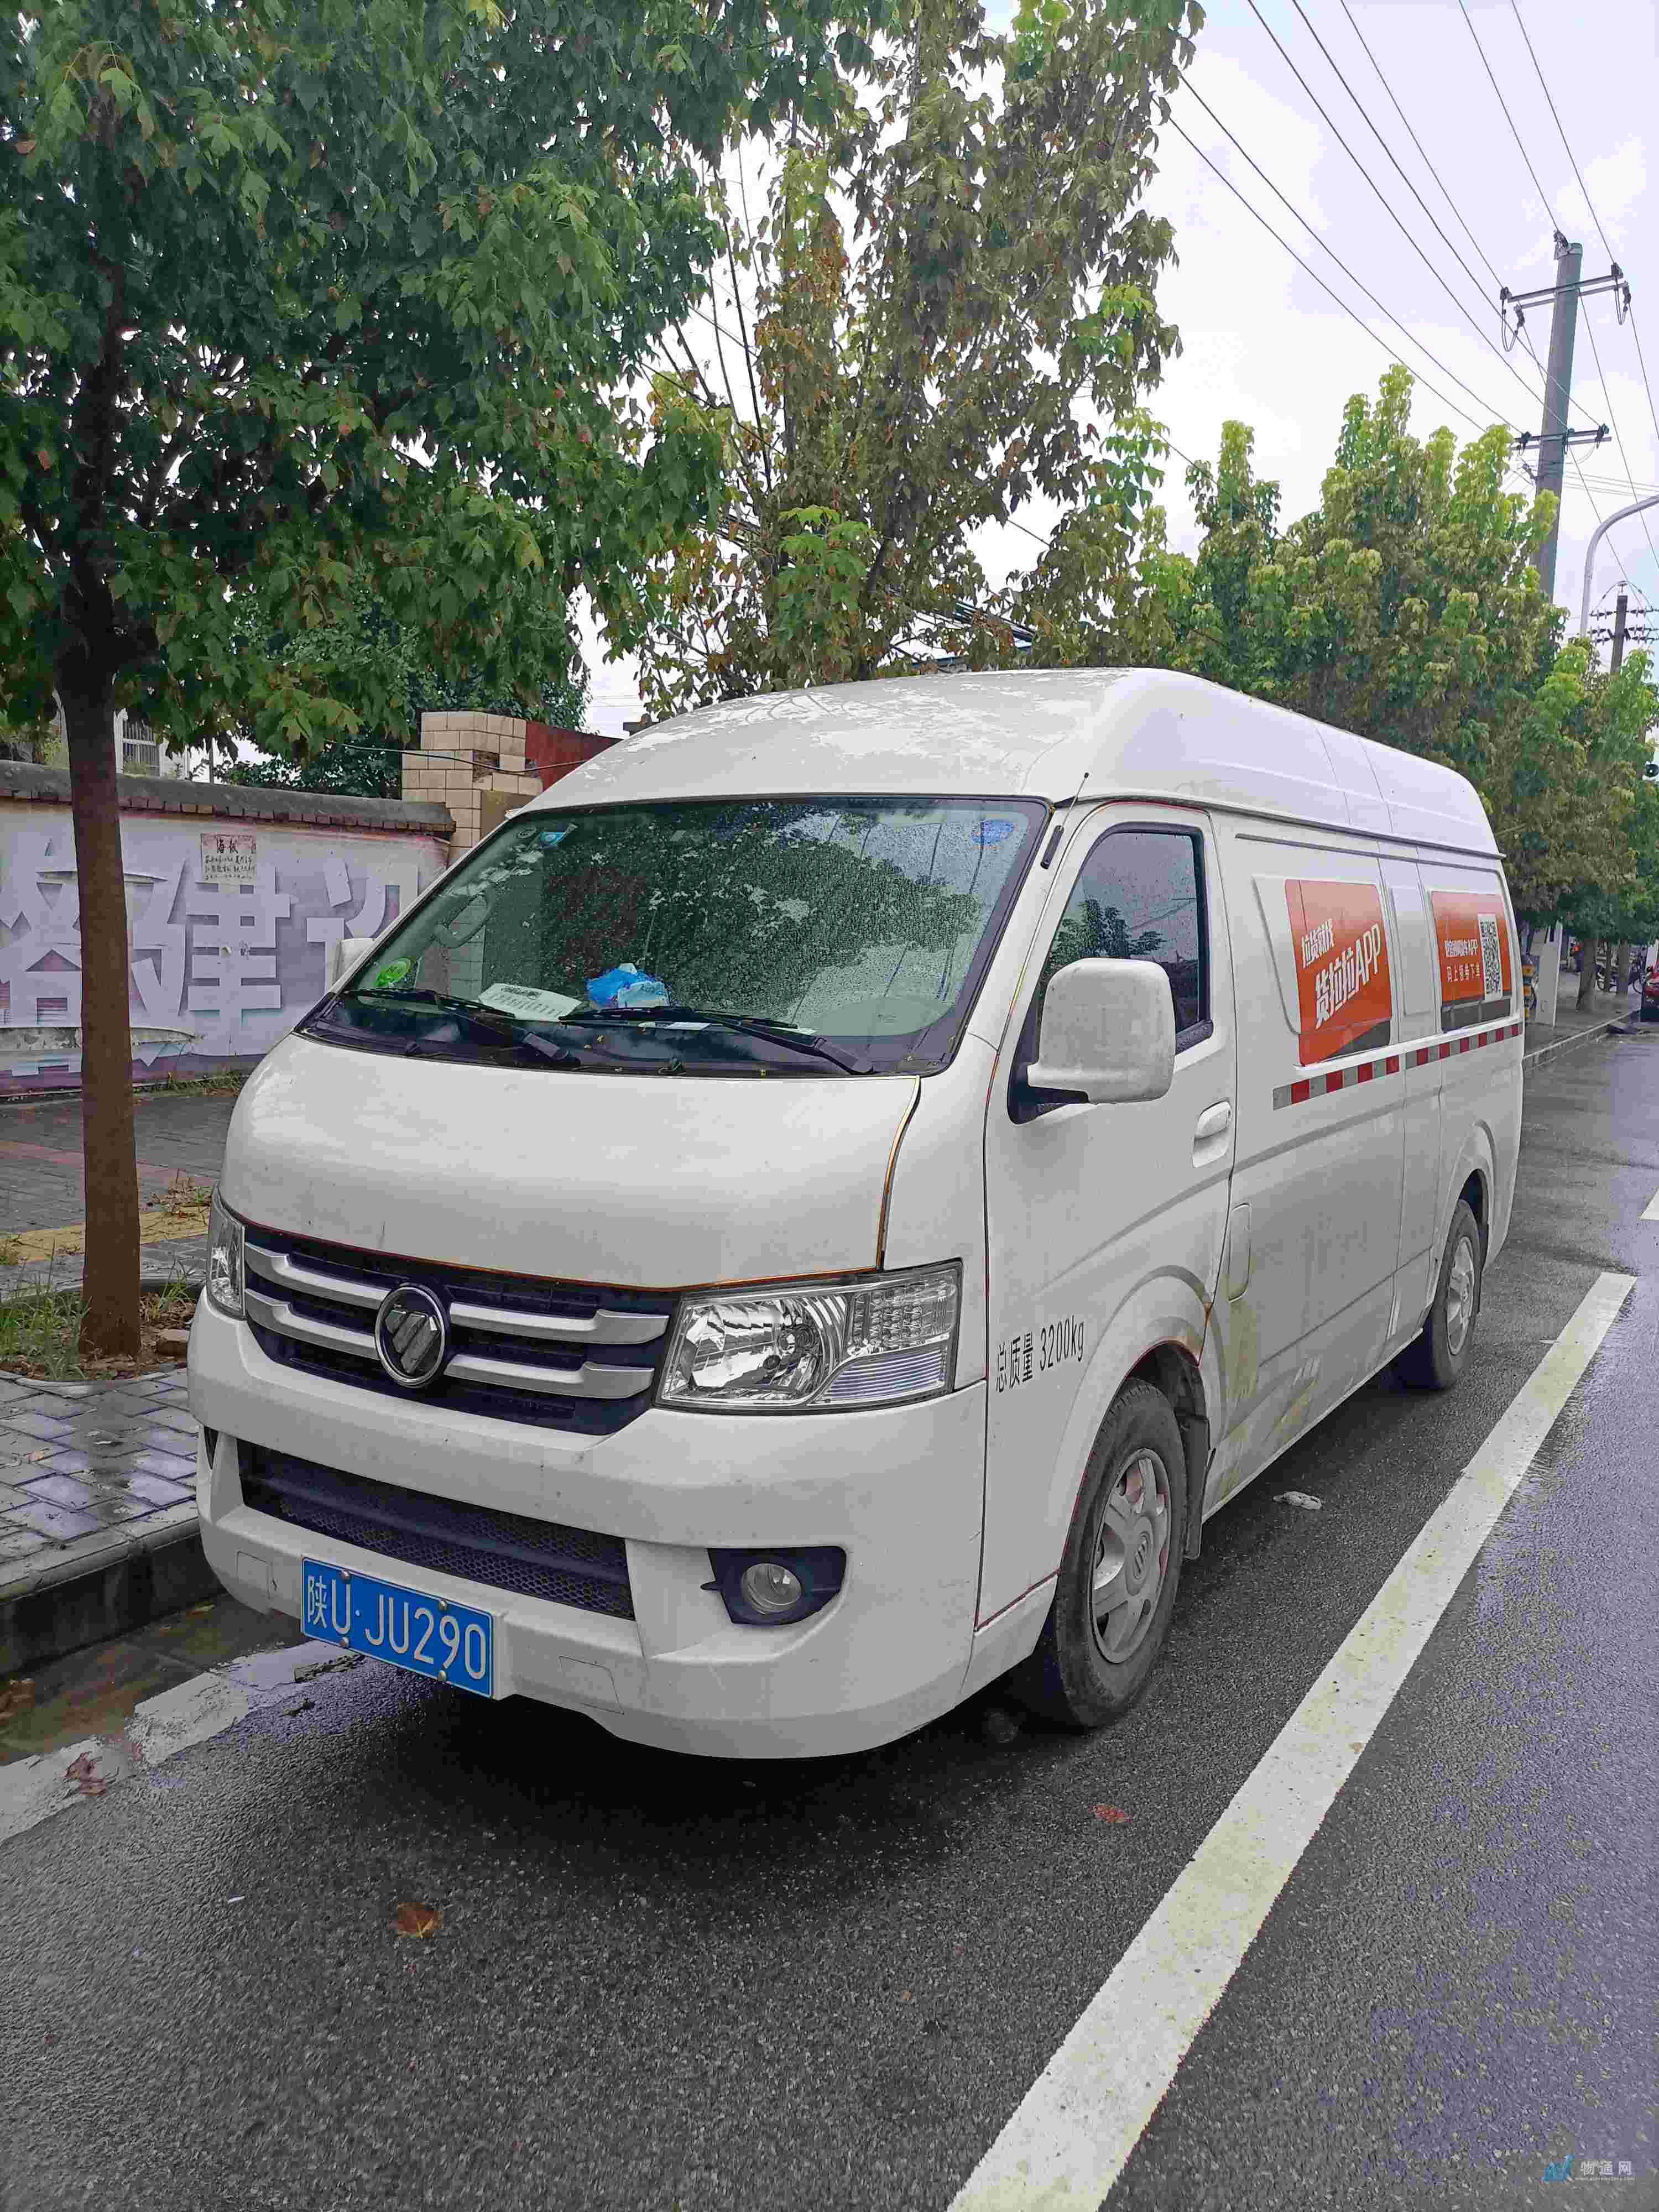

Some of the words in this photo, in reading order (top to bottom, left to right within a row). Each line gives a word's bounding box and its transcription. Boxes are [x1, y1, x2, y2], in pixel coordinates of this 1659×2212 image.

[1315, 922, 1381, 1030] 货拉拉APP
[996, 1331, 1033, 1393] 总质量
[1040, 1314, 1084, 1371] 3200kg
[307, 1574, 487, 1680] 陕U·JU290
